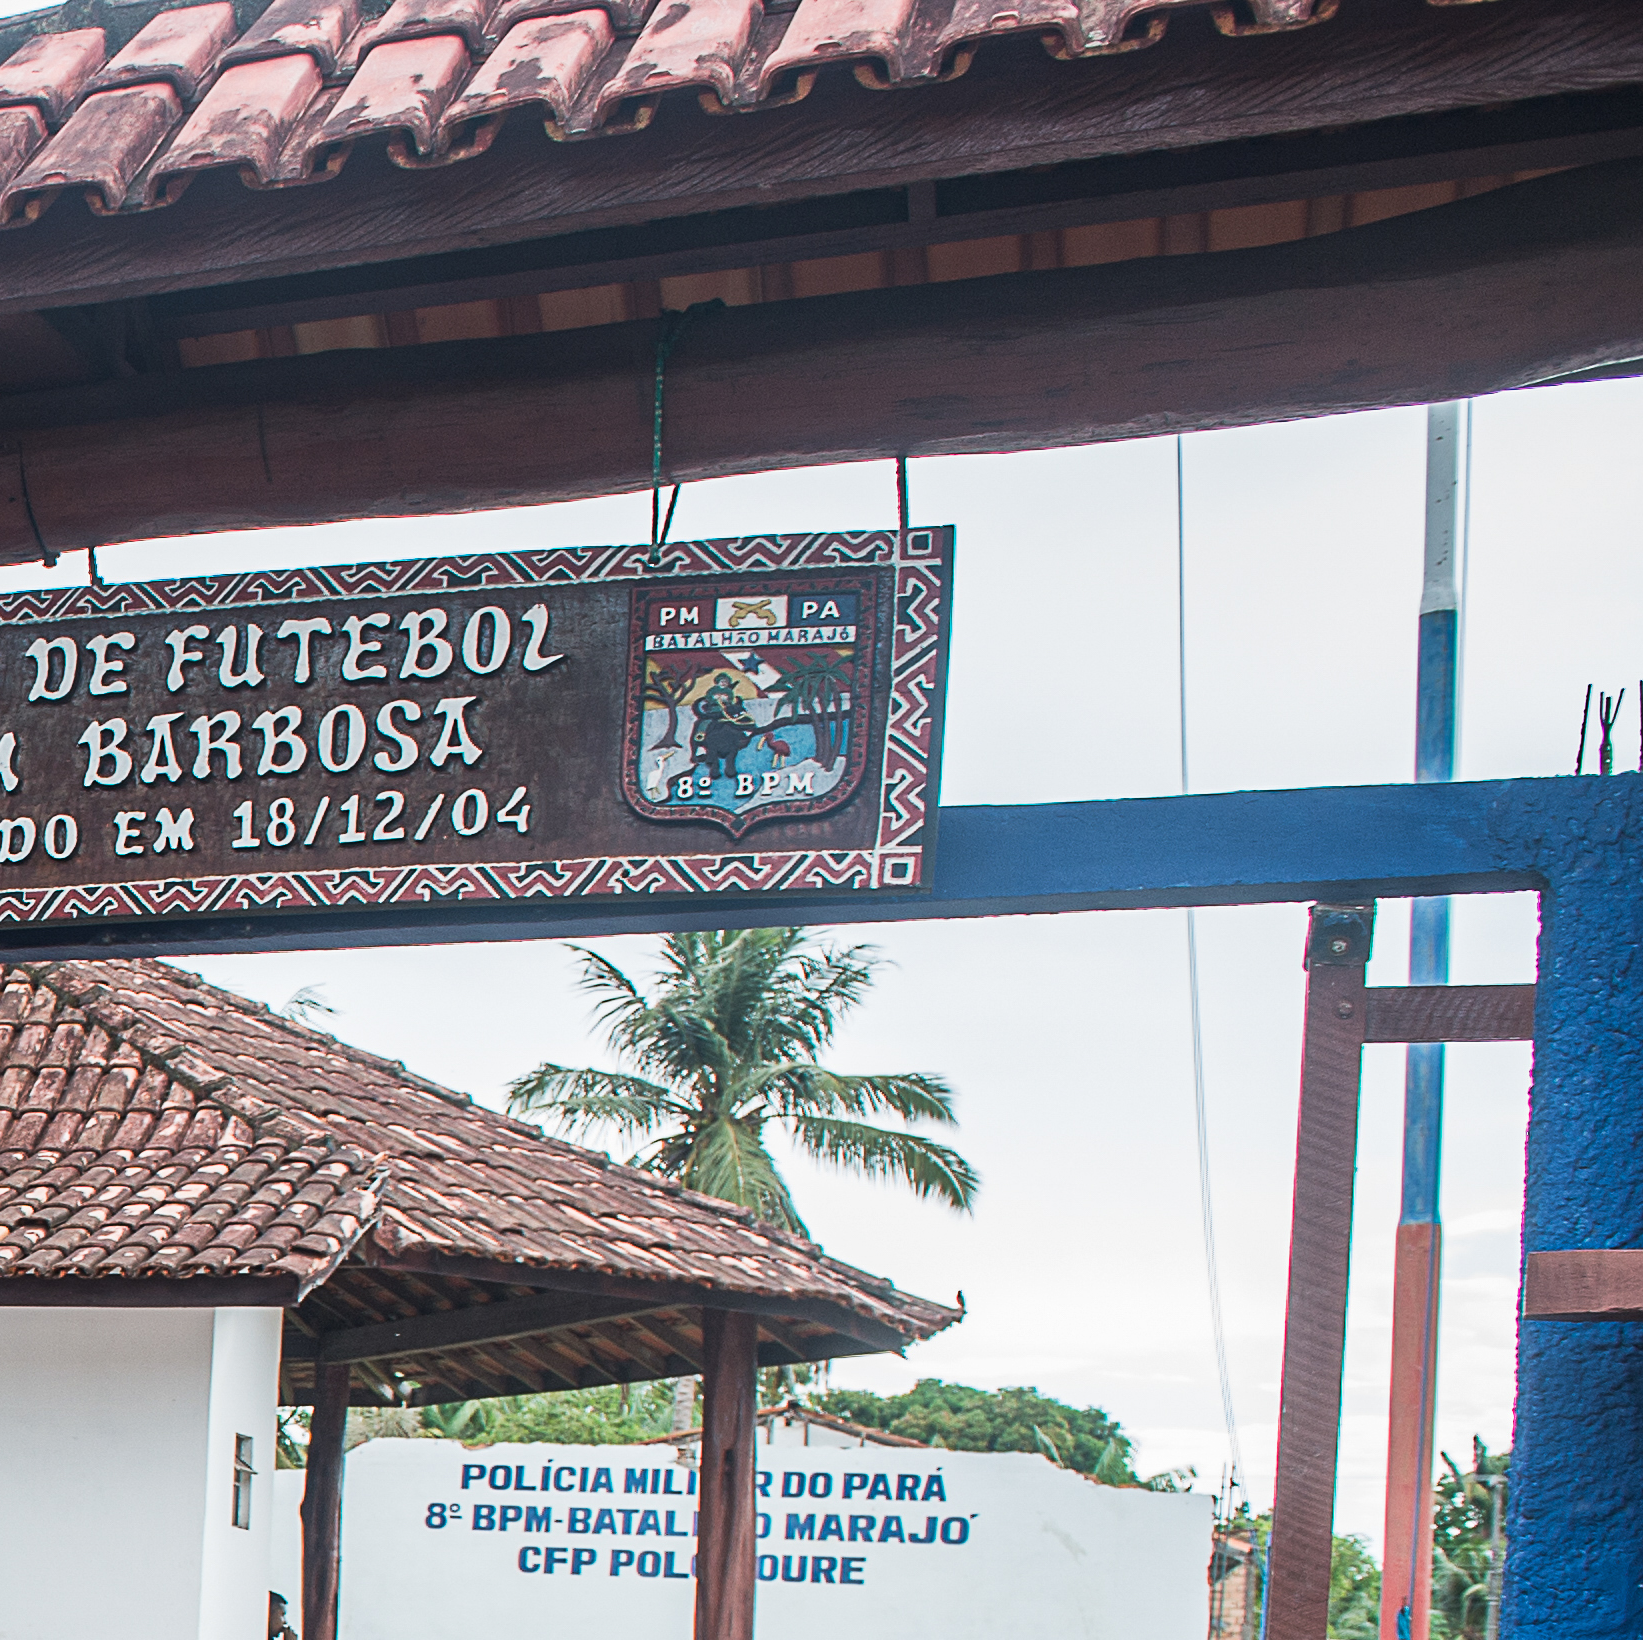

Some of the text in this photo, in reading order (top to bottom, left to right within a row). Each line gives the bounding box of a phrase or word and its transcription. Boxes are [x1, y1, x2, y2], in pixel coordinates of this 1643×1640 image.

[659, 600, 841, 626] PM PA
[24, 630, 136, 702] DE
[164, 603, 565, 693] FUTEBOL
[77, 695, 484, 788] BARBOSA
[735, 771, 816, 797] BPM
[113, 806, 195, 856] EM
[231, 785, 530, 850] 18/12/04
[460, 1458, 947, 1502] POLÍCIA MILIR DO PARÁ
[518, 1546, 867, 1585] CFP POL OURE
